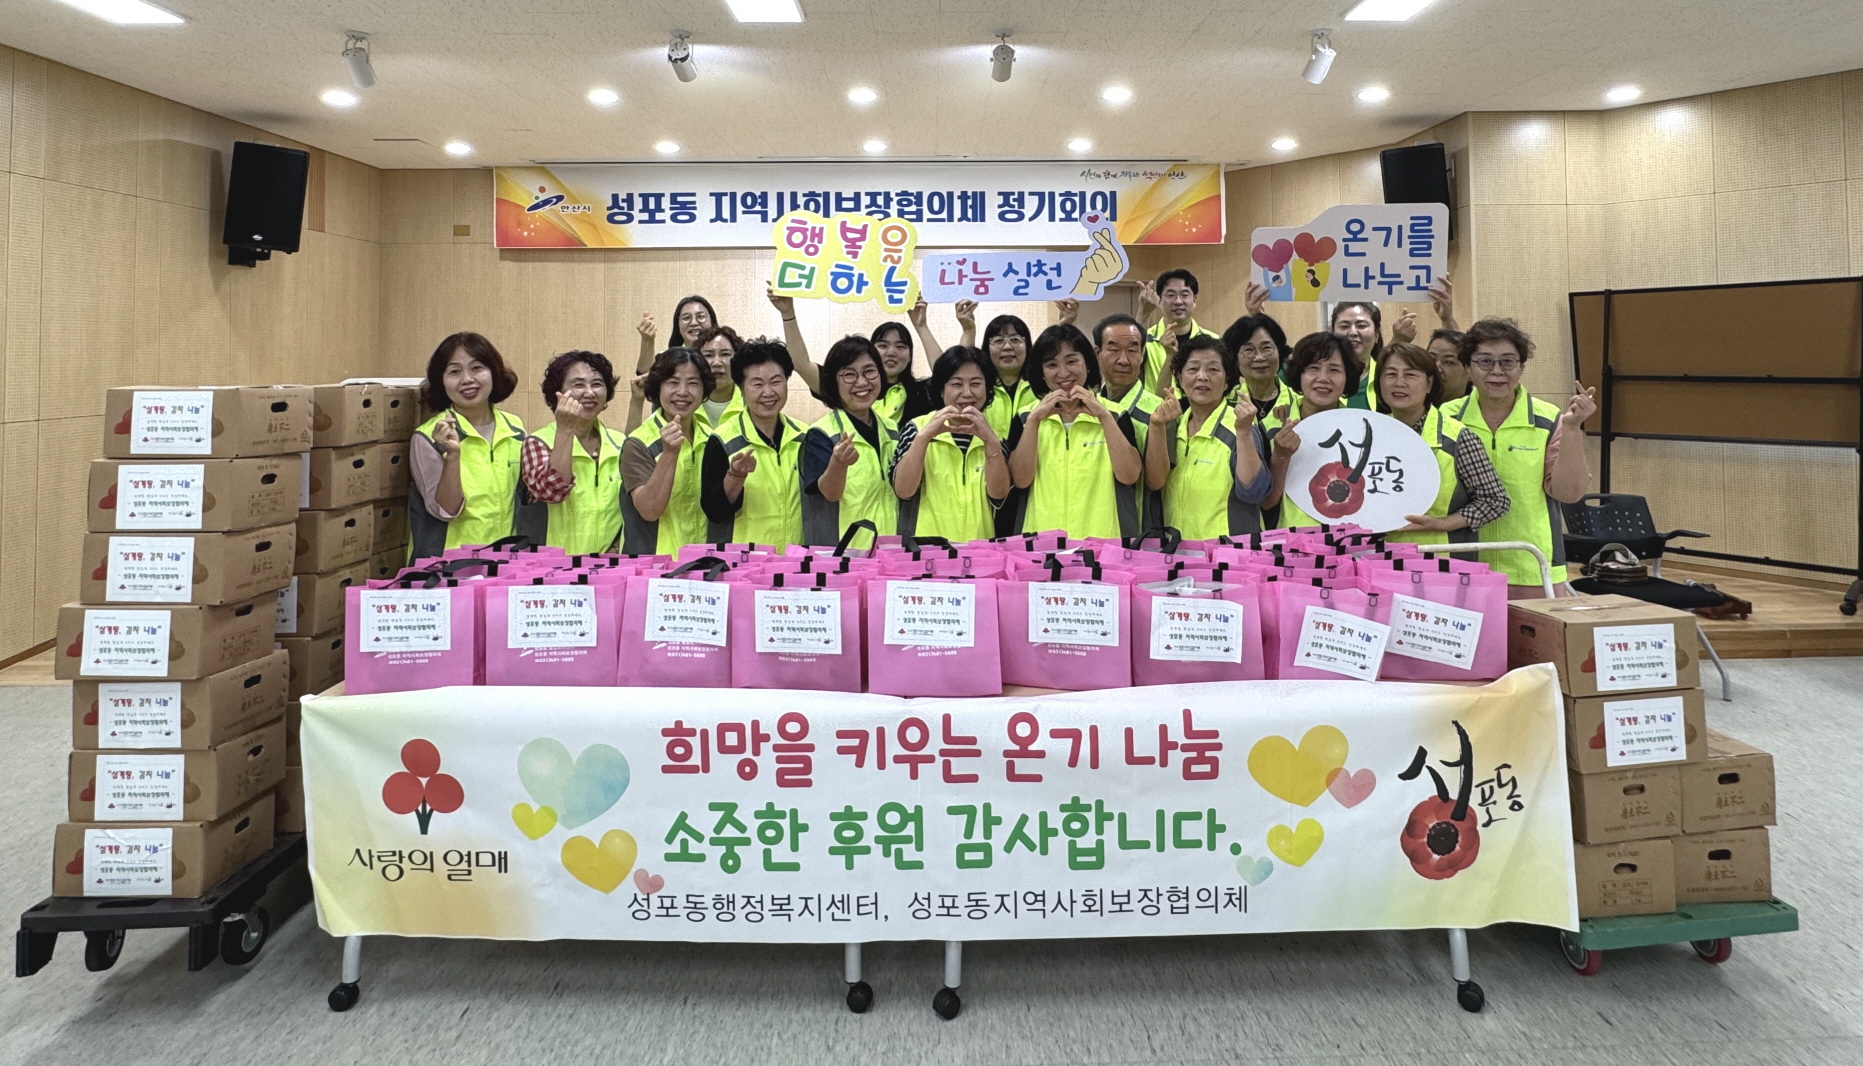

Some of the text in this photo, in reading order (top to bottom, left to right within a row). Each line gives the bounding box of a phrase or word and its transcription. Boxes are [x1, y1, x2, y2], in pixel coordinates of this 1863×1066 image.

[560, 204, 591, 213] 안산시
[606, 192, 697, 224] 성포동
[997, 190, 1117, 222] 정기회의
[786, 218, 908, 264] 행복을
[1342, 216, 1435, 258] 온기를
[939, 259, 1062, 296] 나눔 실천
[1342, 262, 1432, 295] 나누고
[778, 261, 908, 304] 더하는
[170, 405, 183, 413] 감자
[159, 479, 172, 488] 감자
[149, 552, 162, 560] 감자
[551, 599, 565, 607] 감자
[688, 595, 701, 604] 감자
[929, 596, 943, 605] 감자
[1072, 597, 1086, 606] 감자
[403, 603, 417, 612] 감자
[795, 605, 808, 614] 감자
[1196, 612, 1210, 622] 감자
[1432, 616, 1448, 626] 감자
[125, 626, 139, 634] 감자
[1634, 641, 1646, 650] 감자
[138, 698, 151, 706] 감자
[1643, 714, 1656, 724] 감자
[661, 708, 1224, 788] 희망을 키우는 온기 나눔
[138, 770, 152, 779] 감자
[664, 794, 1243, 875] 소중한 후원 감사합니다.
[347, 846, 509, 882] 사랑의 열매
[627, 884, 1250, 924] 성포동행정복지센터, 성포동지역사회보장협의체
